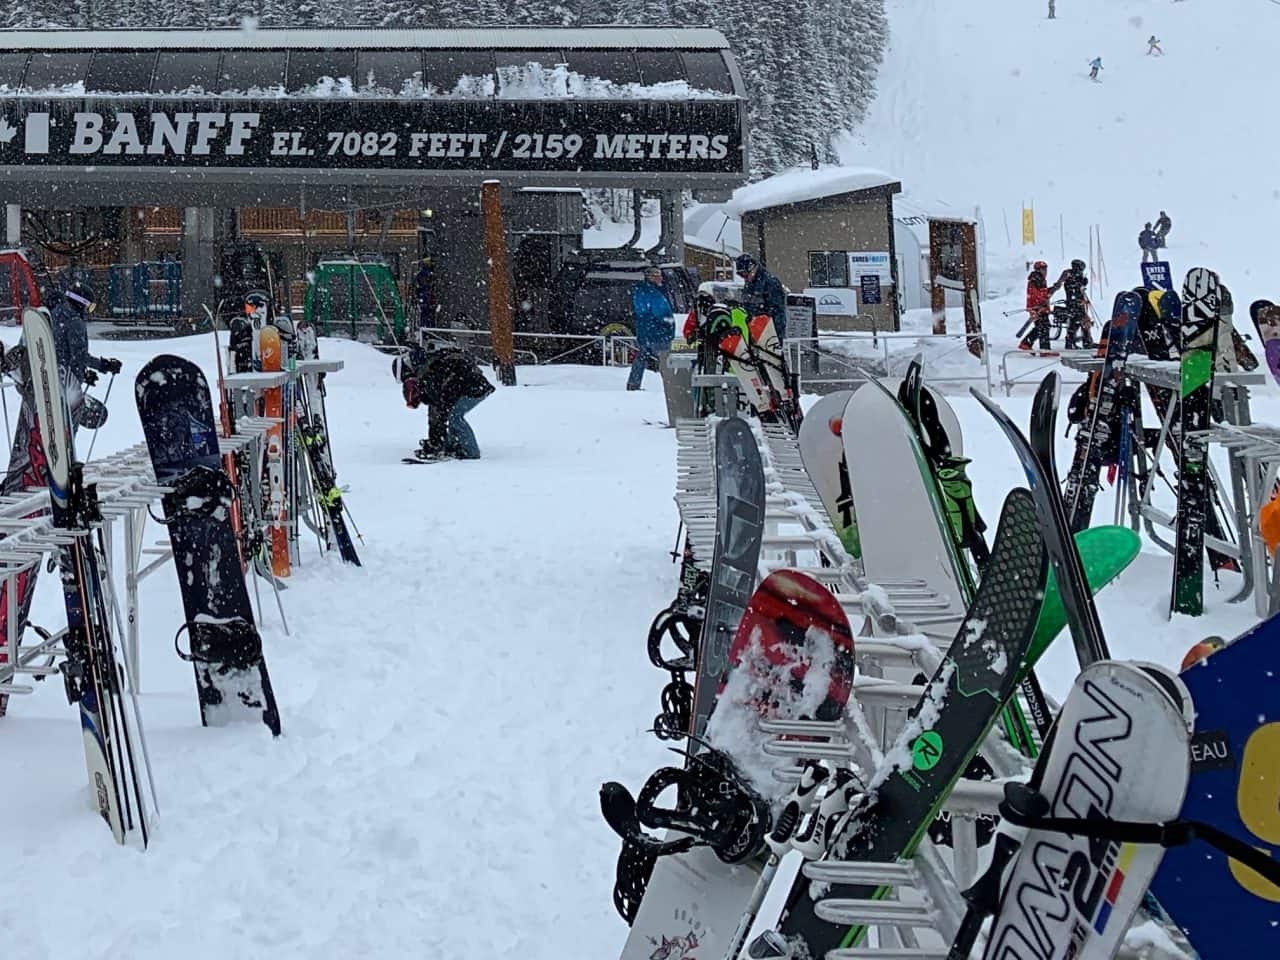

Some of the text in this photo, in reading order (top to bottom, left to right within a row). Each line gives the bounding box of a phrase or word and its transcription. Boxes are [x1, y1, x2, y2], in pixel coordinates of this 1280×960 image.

[70, 113, 259, 154] BANFF
[271, 132, 314, 155] EL.
[328, 131, 397, 156] 7082
[409, 133, 486, 157] FEET
[513, 133, 582, 158] 2159
[594, 133, 728, 159] METERS
[814, 815, 826, 845] LEKI
